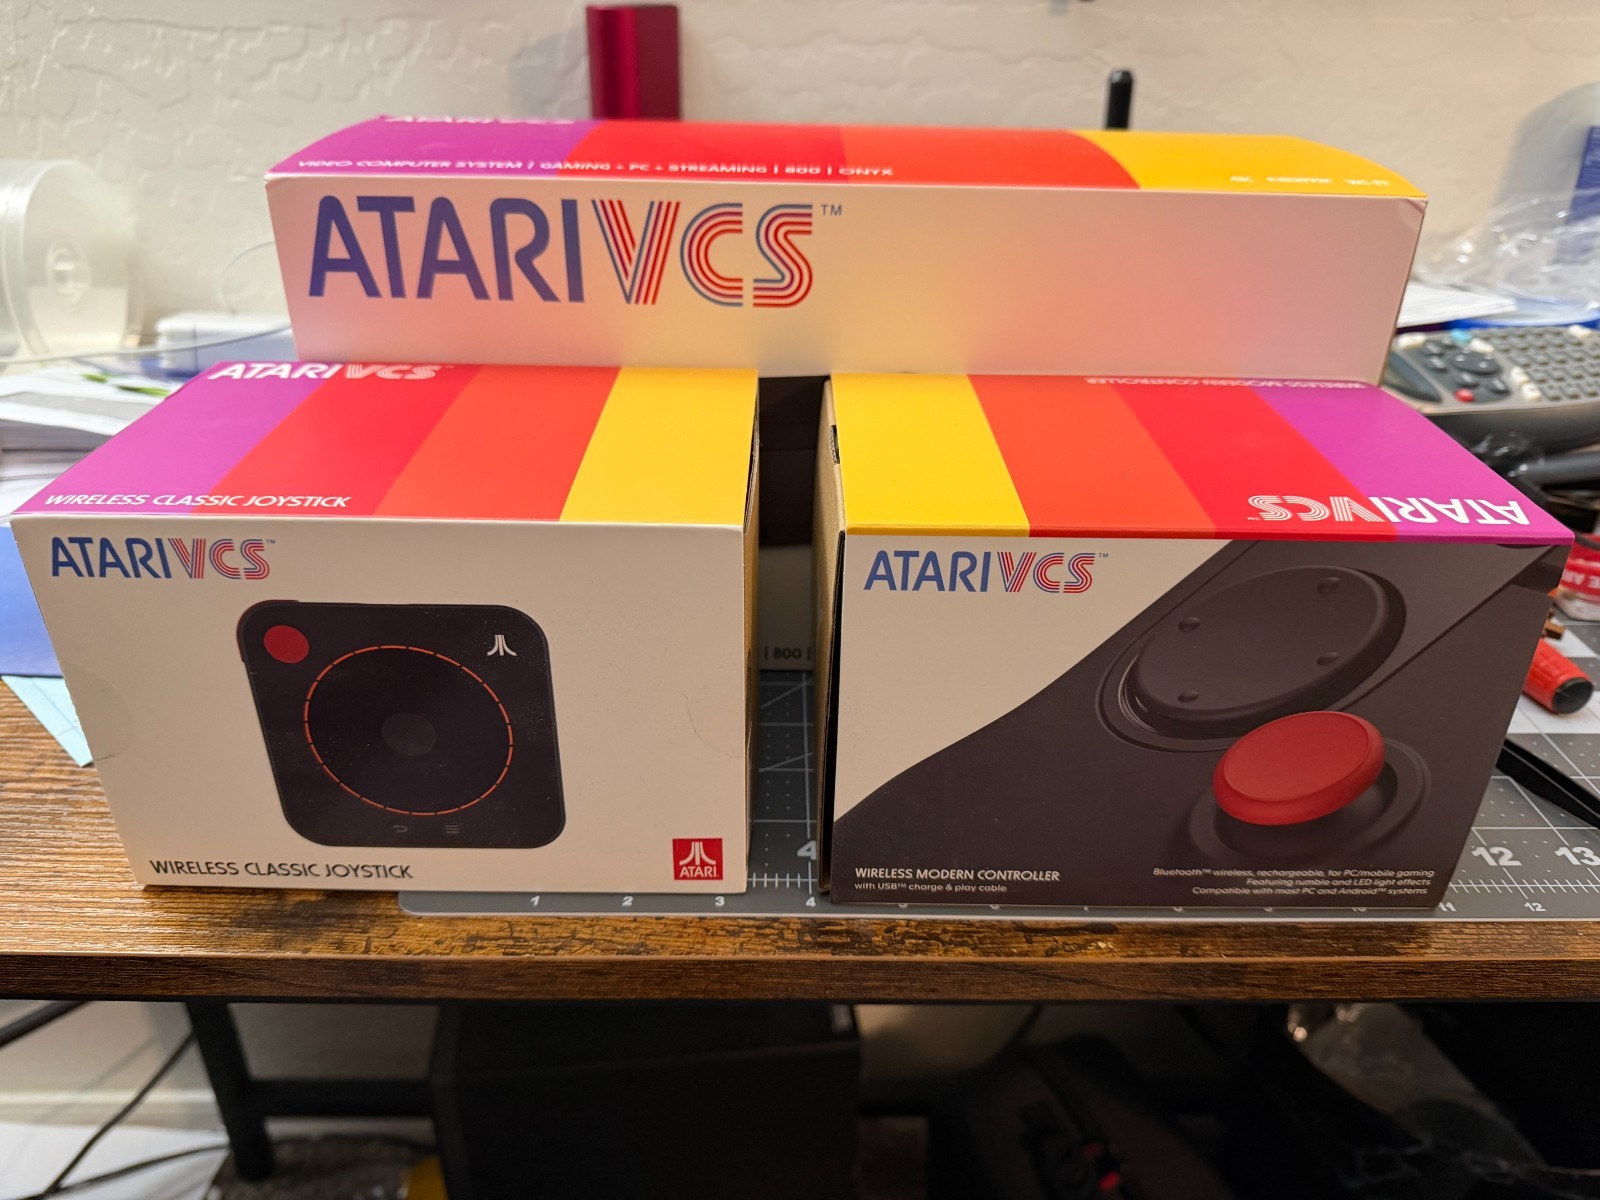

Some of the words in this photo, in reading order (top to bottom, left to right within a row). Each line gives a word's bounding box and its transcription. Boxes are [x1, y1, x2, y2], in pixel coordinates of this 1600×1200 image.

[298, 160, 353, 168] VIDEO
[356, 160, 452, 169] COMPUTER
[454, 161, 524, 170] SYSTEM
[540, 162, 611, 171] GAMING
[629, 163, 650, 172] PC
[667, 163, 768, 174] STREAMING
[784, 166, 821, 175] 800
[837, 166, 894, 177] ONYX
[309, 194, 584, 304] ATARI
[207, 362, 344, 380] ATARI
[44, 493, 150, 506] WIRELESS
[152, 494, 246, 507] CLASSIC
[242, 495, 352, 508] JOYSTICK
[1368, 496, 1531, 526] ATARI
[52, 536, 172, 579] ATARI
[864, 550, 992, 593] ATARI
[773, 647, 802, 660] 800
[797, 840, 817, 860] 4
[1471, 846, 1523, 867] 12
[1554, 846, 1600, 867] 13
[149, 859, 240, 876] WIRELESS
[244, 861, 320, 877] CLASSIC
[325, 863, 414, 879] JOYSTICK
[679, 865, 718, 878] ATARI
[854, 867, 913, 879] WIRELESS
[915, 868, 974, 880] MODERN
[977, 869, 1061, 882] CONTROLLER
[1327, 869, 1342, 878] for
[1343, 869, 1394, 879] PC/mobile
[1396, 869, 1435, 880] gaming
[854, 882, 875, 890] with
[908, 883, 943, 892] charge
[954, 884, 976, 893] play
[978, 884, 1007, 892] cable
[1246, 877, 1294, 888] Featuring
[1295, 878, 1329, 888] rumble
[1330, 878, 1352, 887] and
[1353, 878, 1372, 887] LED
[1373, 878, 1396, 889] light
[1397, 878, 1432, 887] effects
[1192, 886, 1251, 897] Compatible
[1252, 886, 1274, 896] with
[1274, 887, 1301, 896] most
[1302, 887, 1316, 896] PC
[1316, 887, 1338, 896] and
[1386, 887, 1428, 898] systems
[529, 895, 541, 907] 1
[622, 895, 635, 907] 2
[714, 895, 726, 908] 3
[805, 896, 817, 908] 4
[1438, 901, 1457, 912] 11
[1523, 901, 1547, 913] 12
